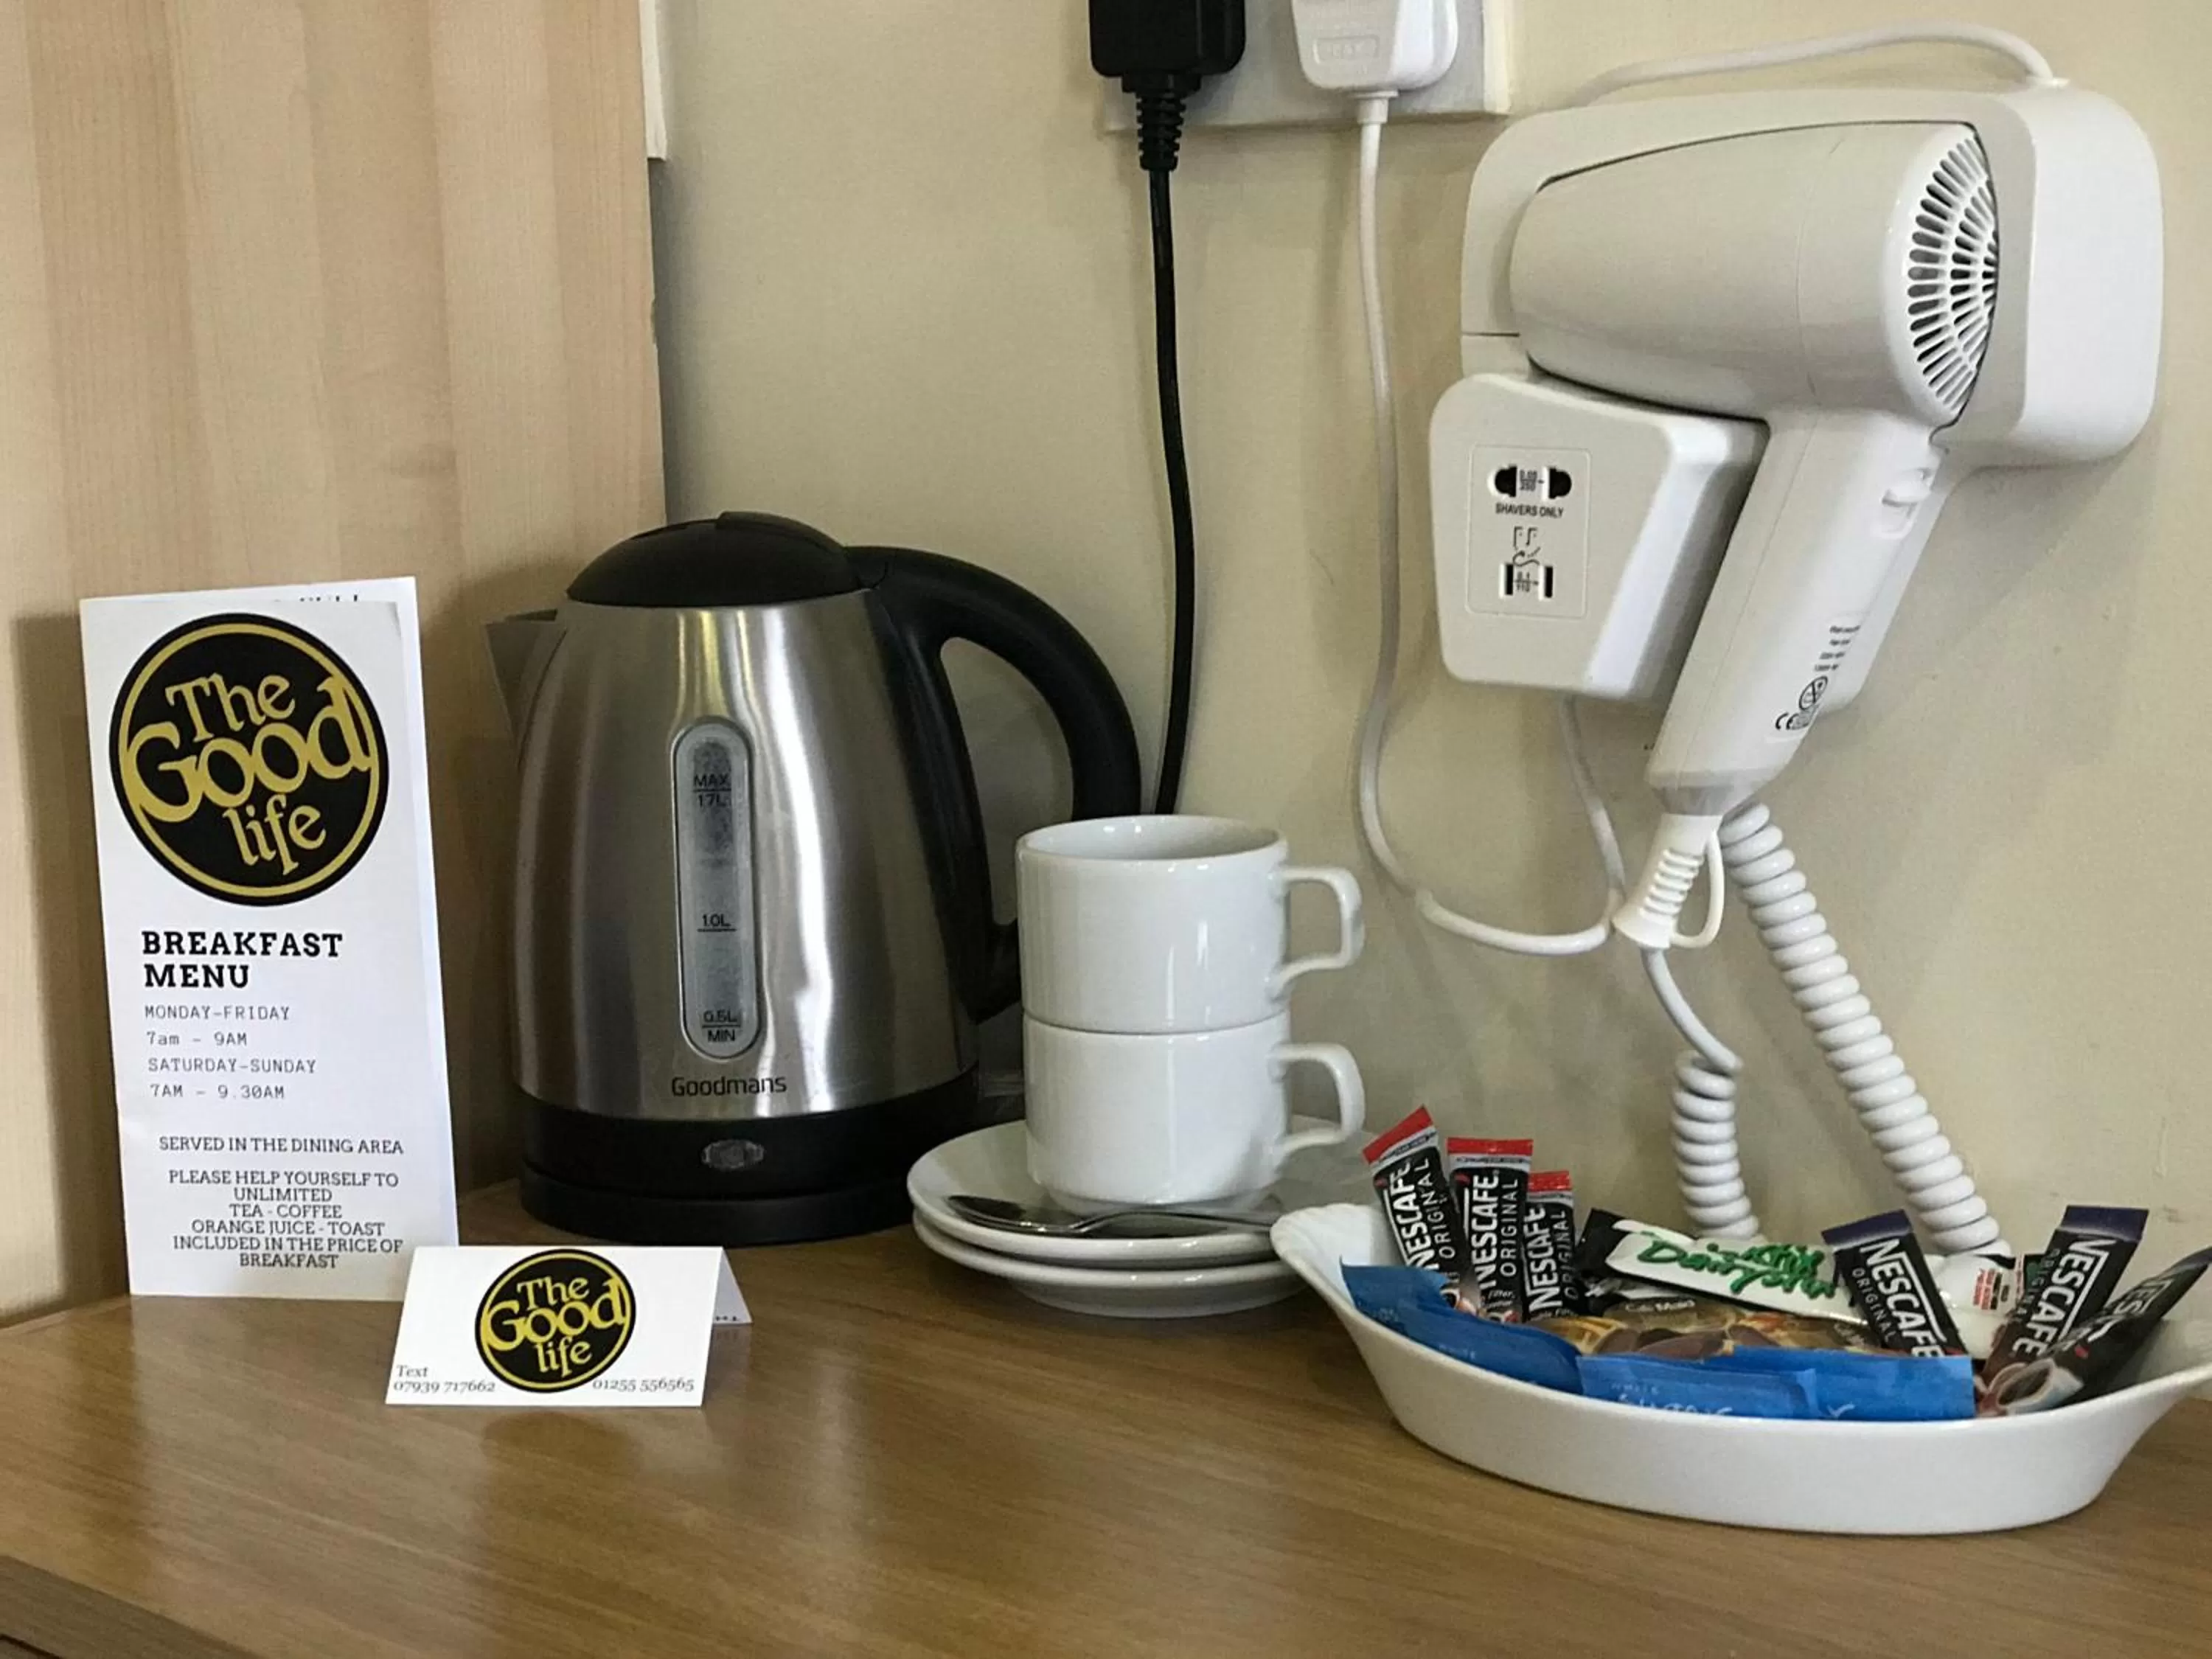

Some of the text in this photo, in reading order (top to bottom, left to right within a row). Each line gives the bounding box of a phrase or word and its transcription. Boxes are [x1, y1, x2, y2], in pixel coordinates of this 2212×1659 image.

[1495, 502, 1564, 518] SHAVERS ONLY
[165, 672, 296, 742] The
[125, 676, 373, 823] Good
[693, 773, 728, 787] MAX
[223, 793, 327, 876] life
[142, 931, 344, 958] BREAKFAST
[143, 964, 251, 988] MENU
[146, 1031, 180, 1046] 7am
[214, 1032, 248, 1046] 9AM
[708, 1029, 737, 1043] MIN
[150, 1083, 184, 1099] 7AM
[217, 1085, 285, 1100] 9.30AM
[672, 1075, 787, 1097] Goodmans
[159, 1136, 404, 1155] SERVED IN THE DINING AREA
[168, 1170, 399, 1187] PLEASE HELP YOURSELF TO
[233, 1188, 333, 1203] UNLIMITED
[229, 1204, 263, 1218] TEA
[276, 1204, 343, 1219] COFFEE
[1413, 1158, 1455, 1259] ORIGINAL
[191, 1220, 265, 1234] ORANGE
[269, 1220, 316, 1236] JUICE
[327, 1221, 386, 1237] TOAST
[1500, 1179, 1519, 1277] ORIGINAL
[173, 1236, 404, 1253] INCLUDED IN THE PRICE OF
[239, 1253, 339, 1268] BREAKFAST
[1550, 1210, 1579, 1300] ORIGINAL
[517, 1276, 591, 1310] The
[1851, 1266, 1900, 1342] ORIGINAL
[486, 1276, 627, 1352] Good
[535, 1336, 592, 1377] life
[397, 1364, 428, 1378] Text
[393, 1379, 496, 1394] 07939 717662
[592, 1377, 695, 1393] 01255 556565
